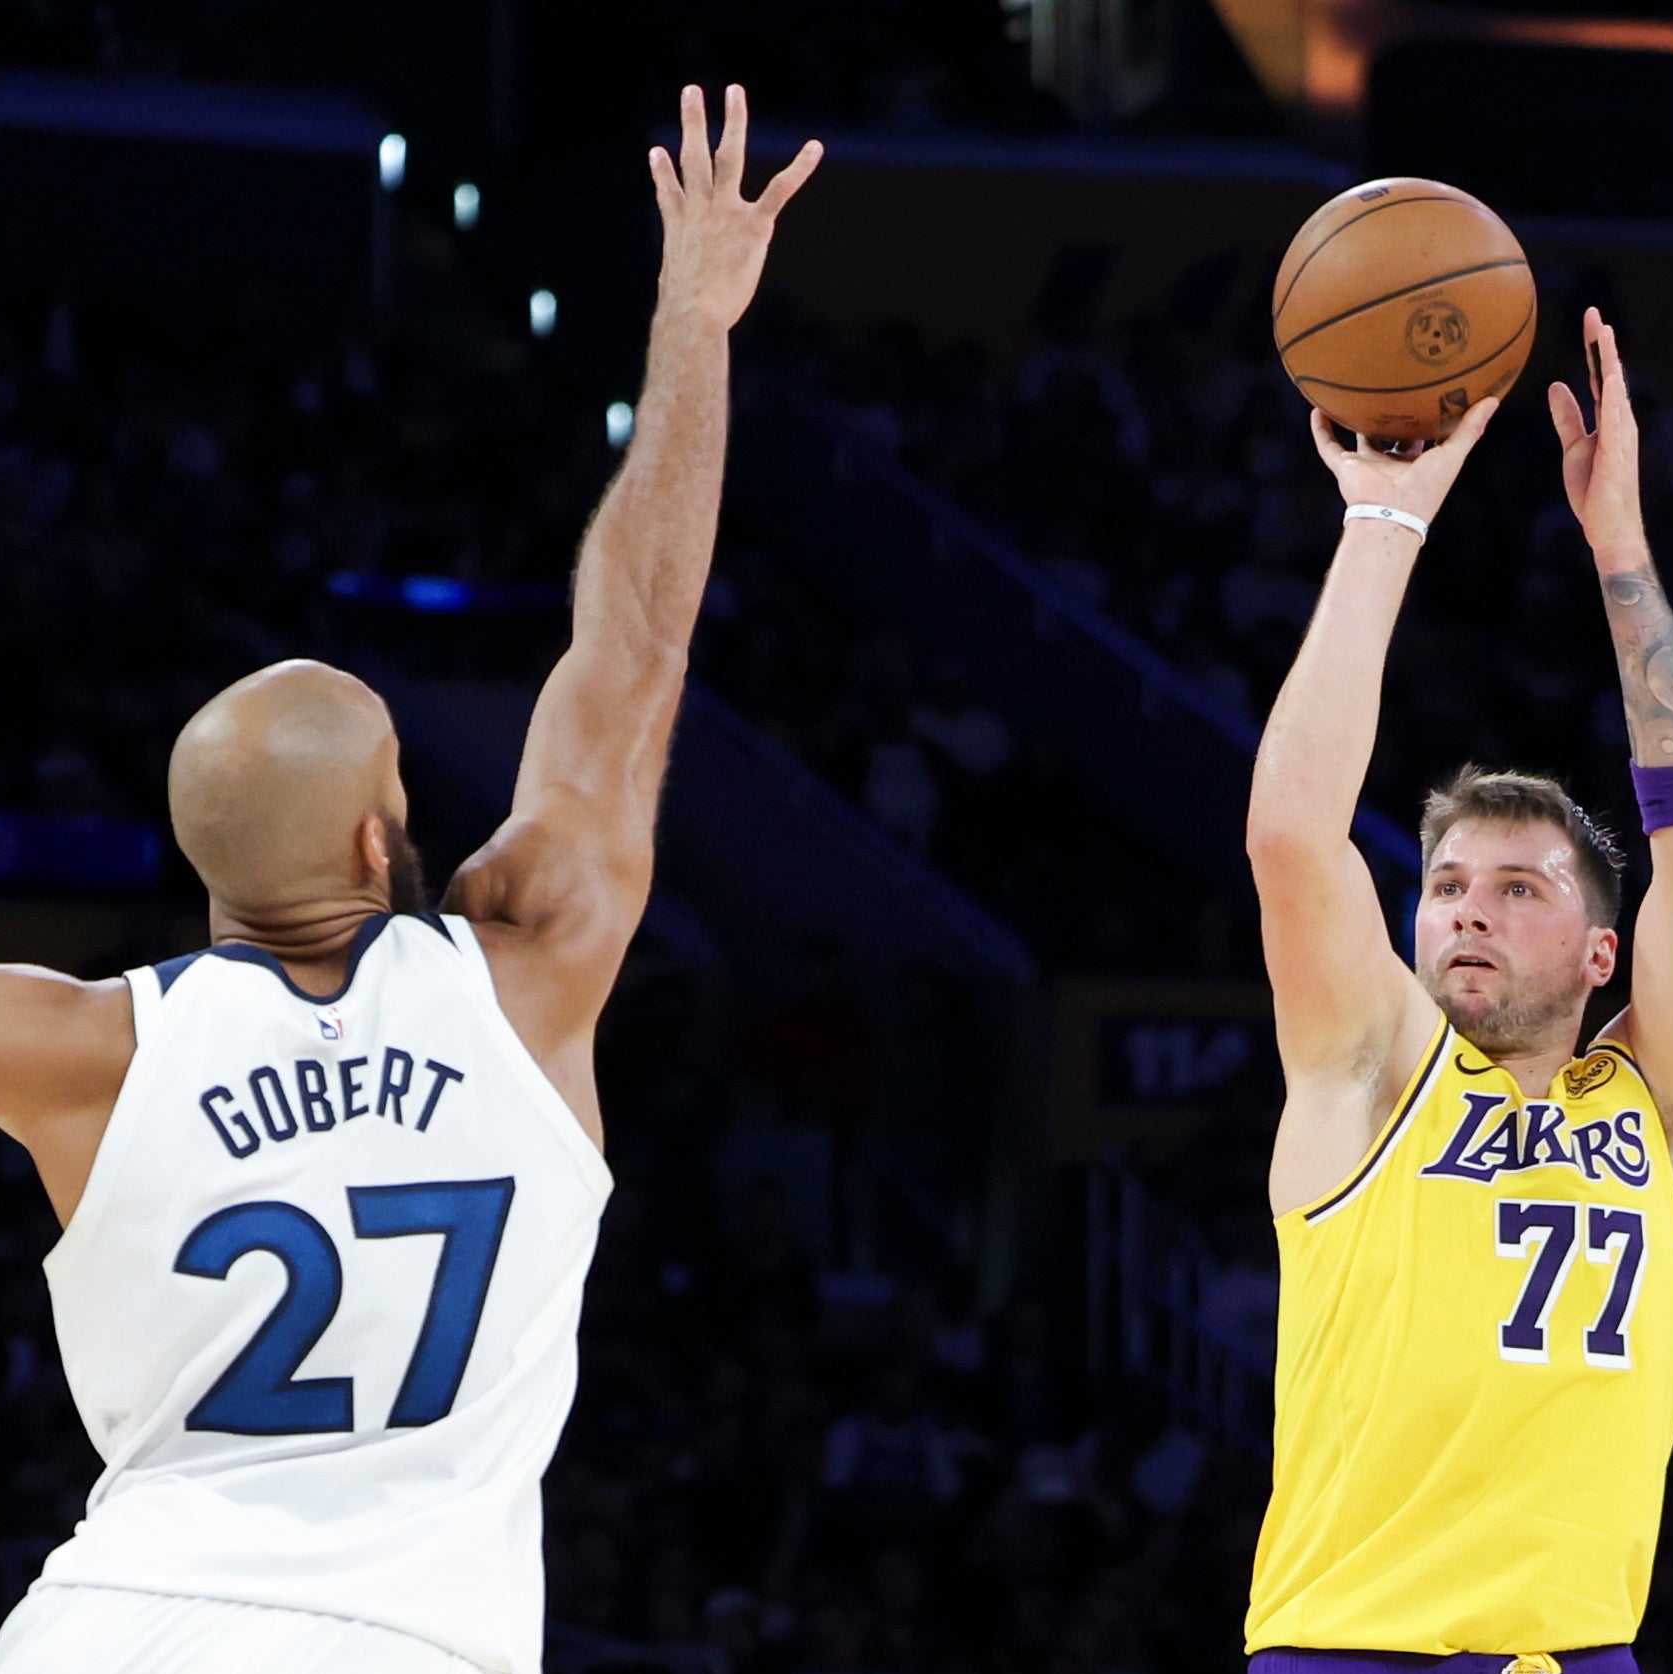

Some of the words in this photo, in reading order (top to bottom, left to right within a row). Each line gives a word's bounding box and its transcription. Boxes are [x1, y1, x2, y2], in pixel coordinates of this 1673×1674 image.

[199, 1046, 464, 1160] GOBERT
[1418, 1090, 1651, 1189] LAKRS
[173, 1175, 515, 1436] 27
[1496, 1199, 1645, 1369] 77
